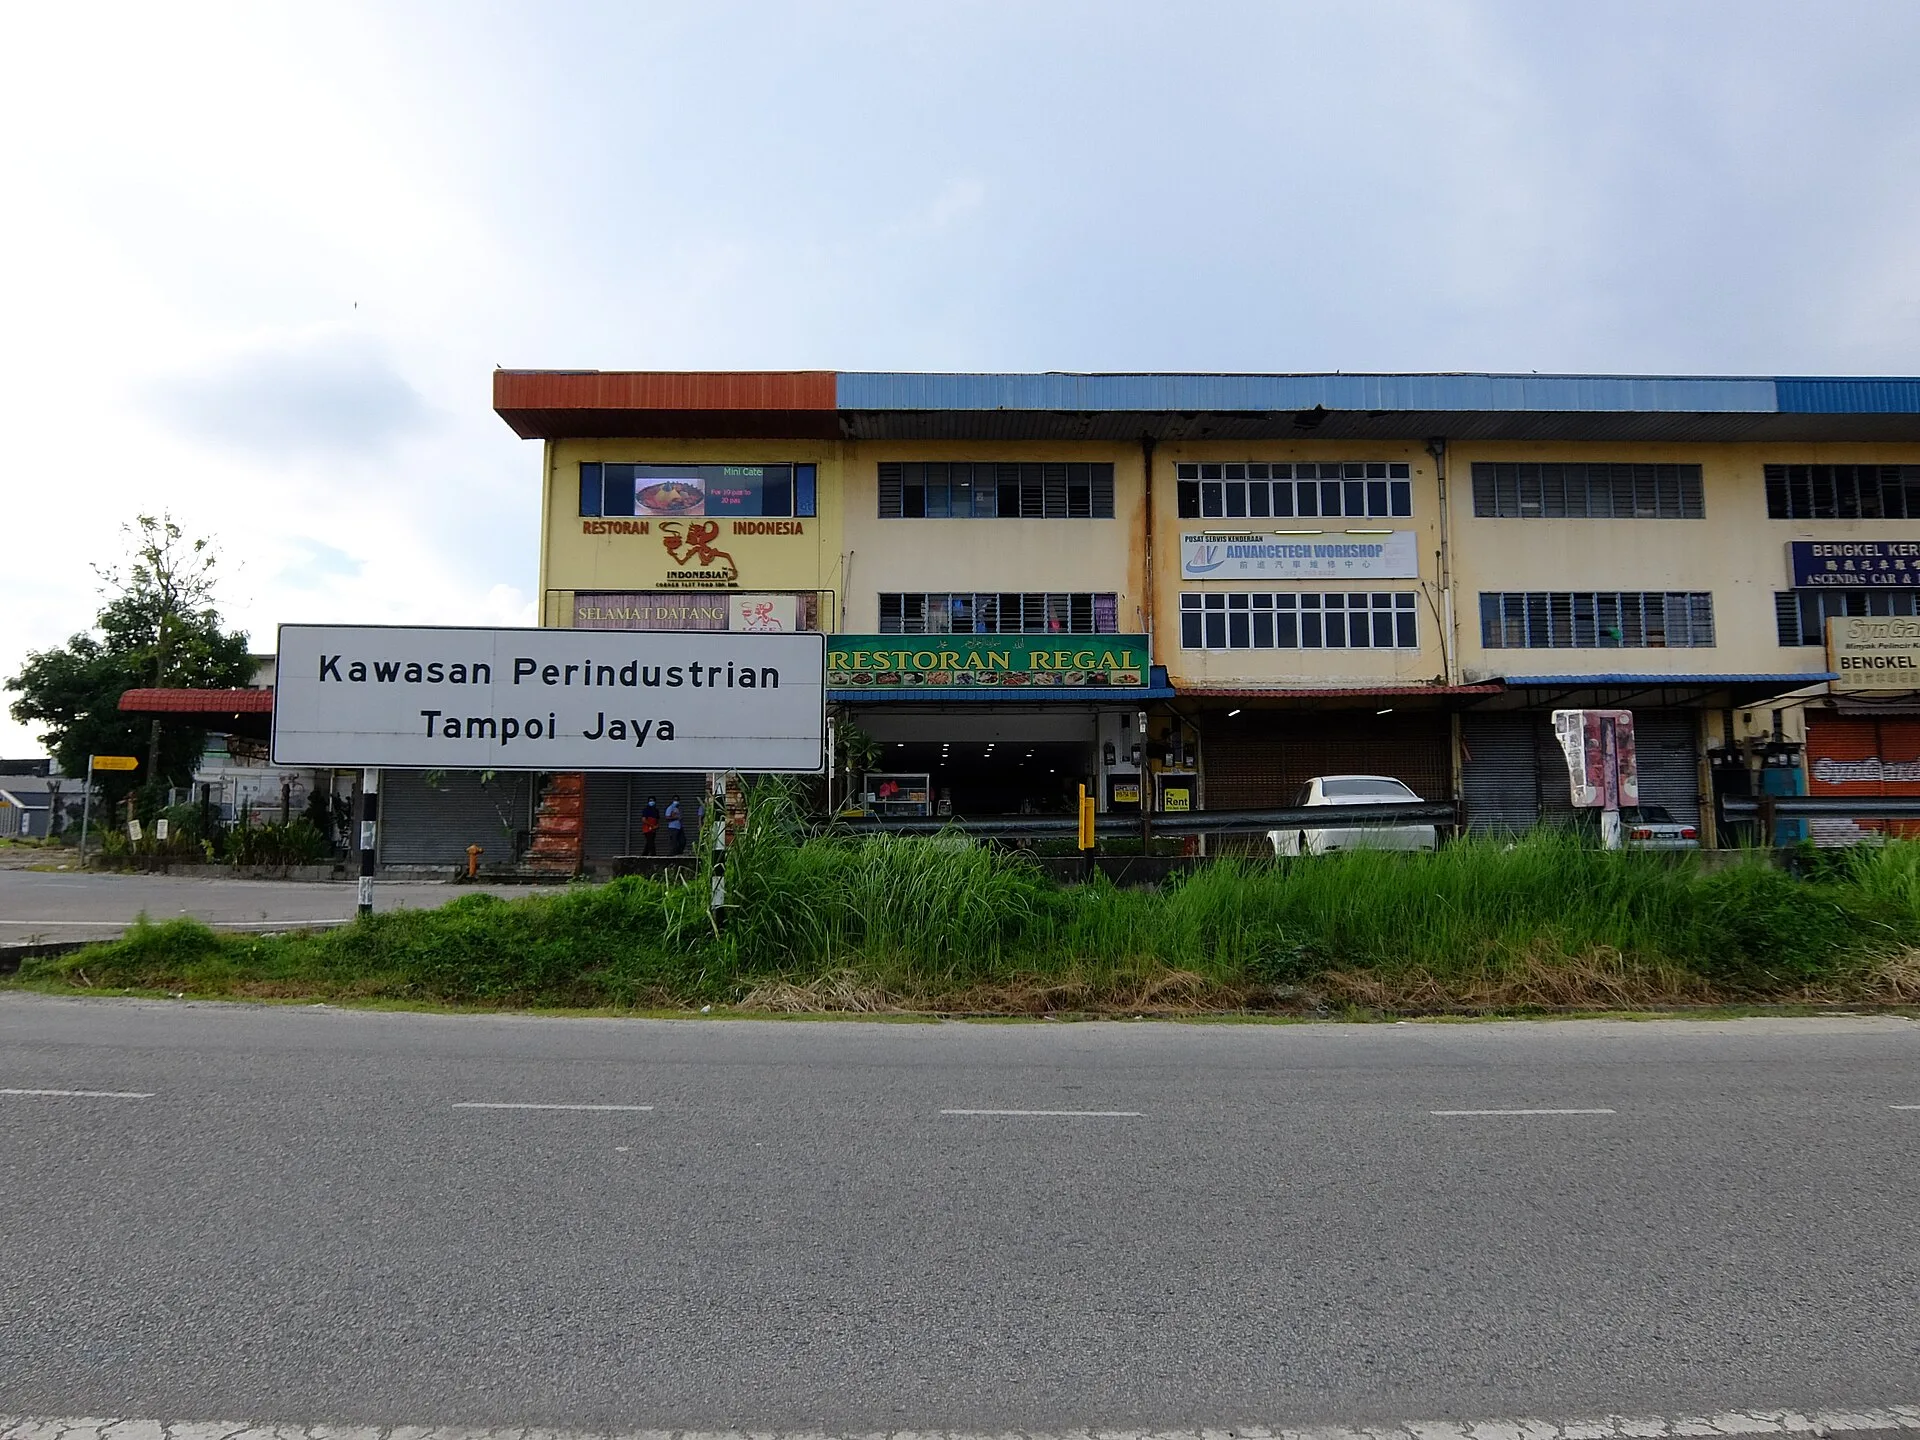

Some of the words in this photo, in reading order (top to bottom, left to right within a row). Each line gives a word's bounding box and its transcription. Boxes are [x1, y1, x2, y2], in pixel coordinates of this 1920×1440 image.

[724, 467, 741, 476] Mini
[583, 521, 649, 535] RESTORAN
[733, 521, 804, 535] INDONESIA
[1184, 535, 1204, 543] PUSAT
[1205, 535, 1227, 543] SERVIS
[1228, 535, 1264, 543] KENDERAAN
[1226, 544, 1312, 558] ADVANCETECH
[1314, 544, 1383, 558] WORKSHOP
[1812, 544, 1883, 556] BENGKEL
[1888, 544, 1920, 556] KER
[667, 571, 729, 579] INDONESIAN
[1807, 574, 1866, 585] ASCENDAS
[1871, 574, 1896, 584] CAR
[1902, 573, 1912, 584] &
[578, 607, 652, 621] SELAMAT
[656, 607, 725, 620] DATANG
[1847, 618, 1920, 643] SynGa
[827, 650, 1010, 670] RESTORAN
[1028, 650, 1141, 670] REGAL
[1841, 656, 1917, 670] BENGKEL
[319, 655, 491, 684] Kawasan
[513, 658, 779, 689] Perindustrian
[420, 710, 555, 746] Tampoi
[583, 712, 675, 748] Jaya
[1166, 797, 1188, 806] Rent
